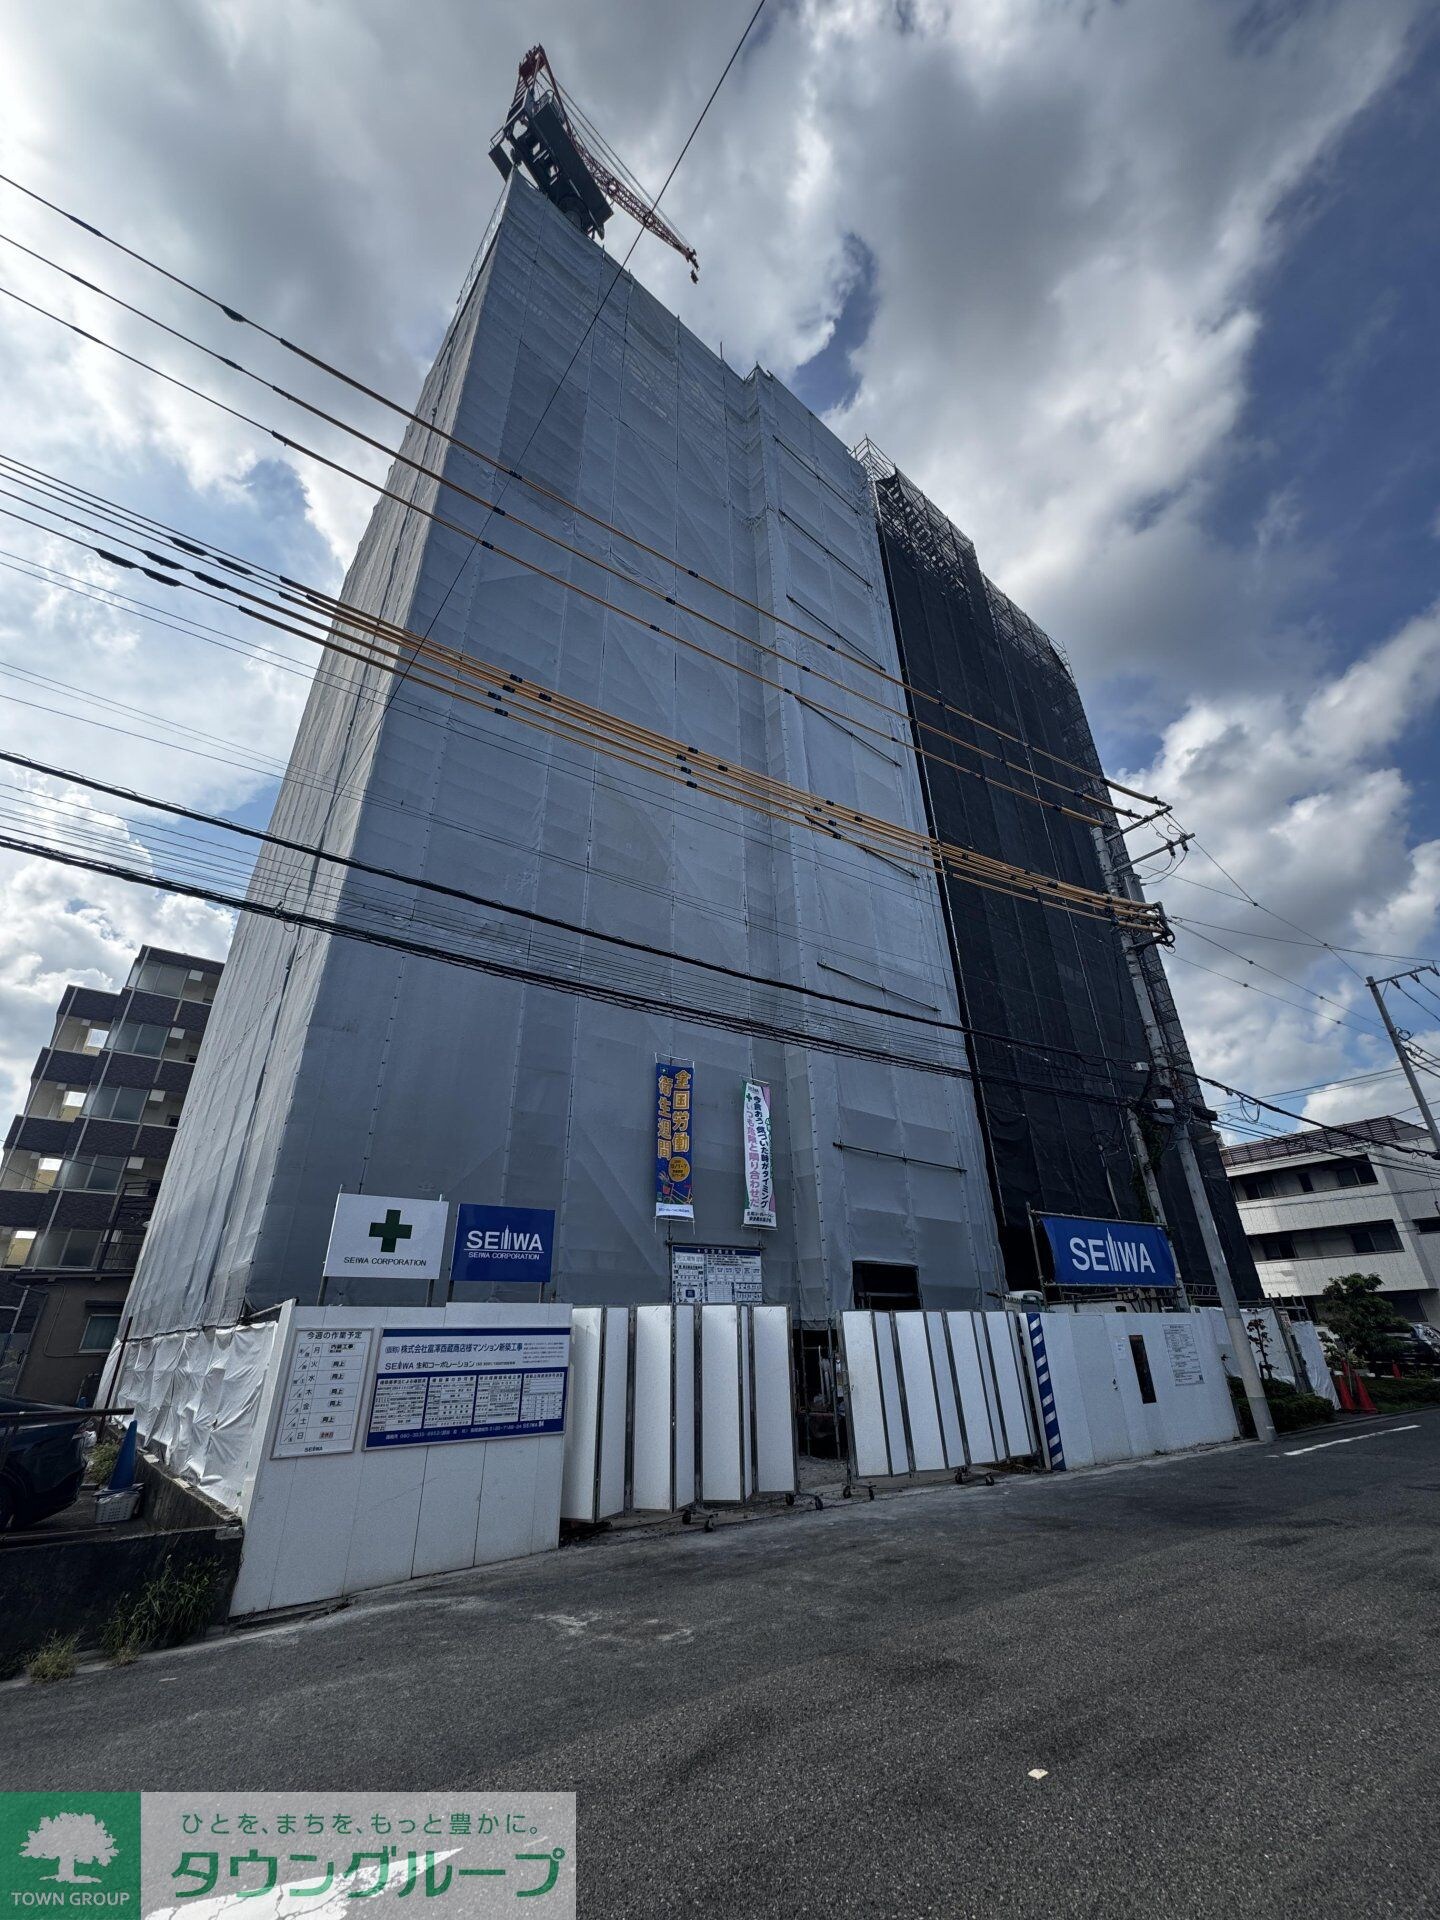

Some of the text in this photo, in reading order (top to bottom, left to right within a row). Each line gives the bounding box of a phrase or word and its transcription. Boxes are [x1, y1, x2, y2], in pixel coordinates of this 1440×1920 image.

[672, 1070, 691, 1152] 全国労働
[658, 1075, 673, 1160] 衛生週間
[466, 1225, 542, 1251] SEIWA
[491, 1252, 539, 1260] CORPORATION
[1069, 1228, 1156, 1274] SEIWA
[344, 1256, 426, 1267] SEIWA CORPORATION
[307, 1331, 362, 1339] 今週の作業予定
[385, 1361, 414, 1370] SEIWA
[416, 1361, 474, 1369] 生和コーポレーション
[297, 1432, 304, 1440] 日
